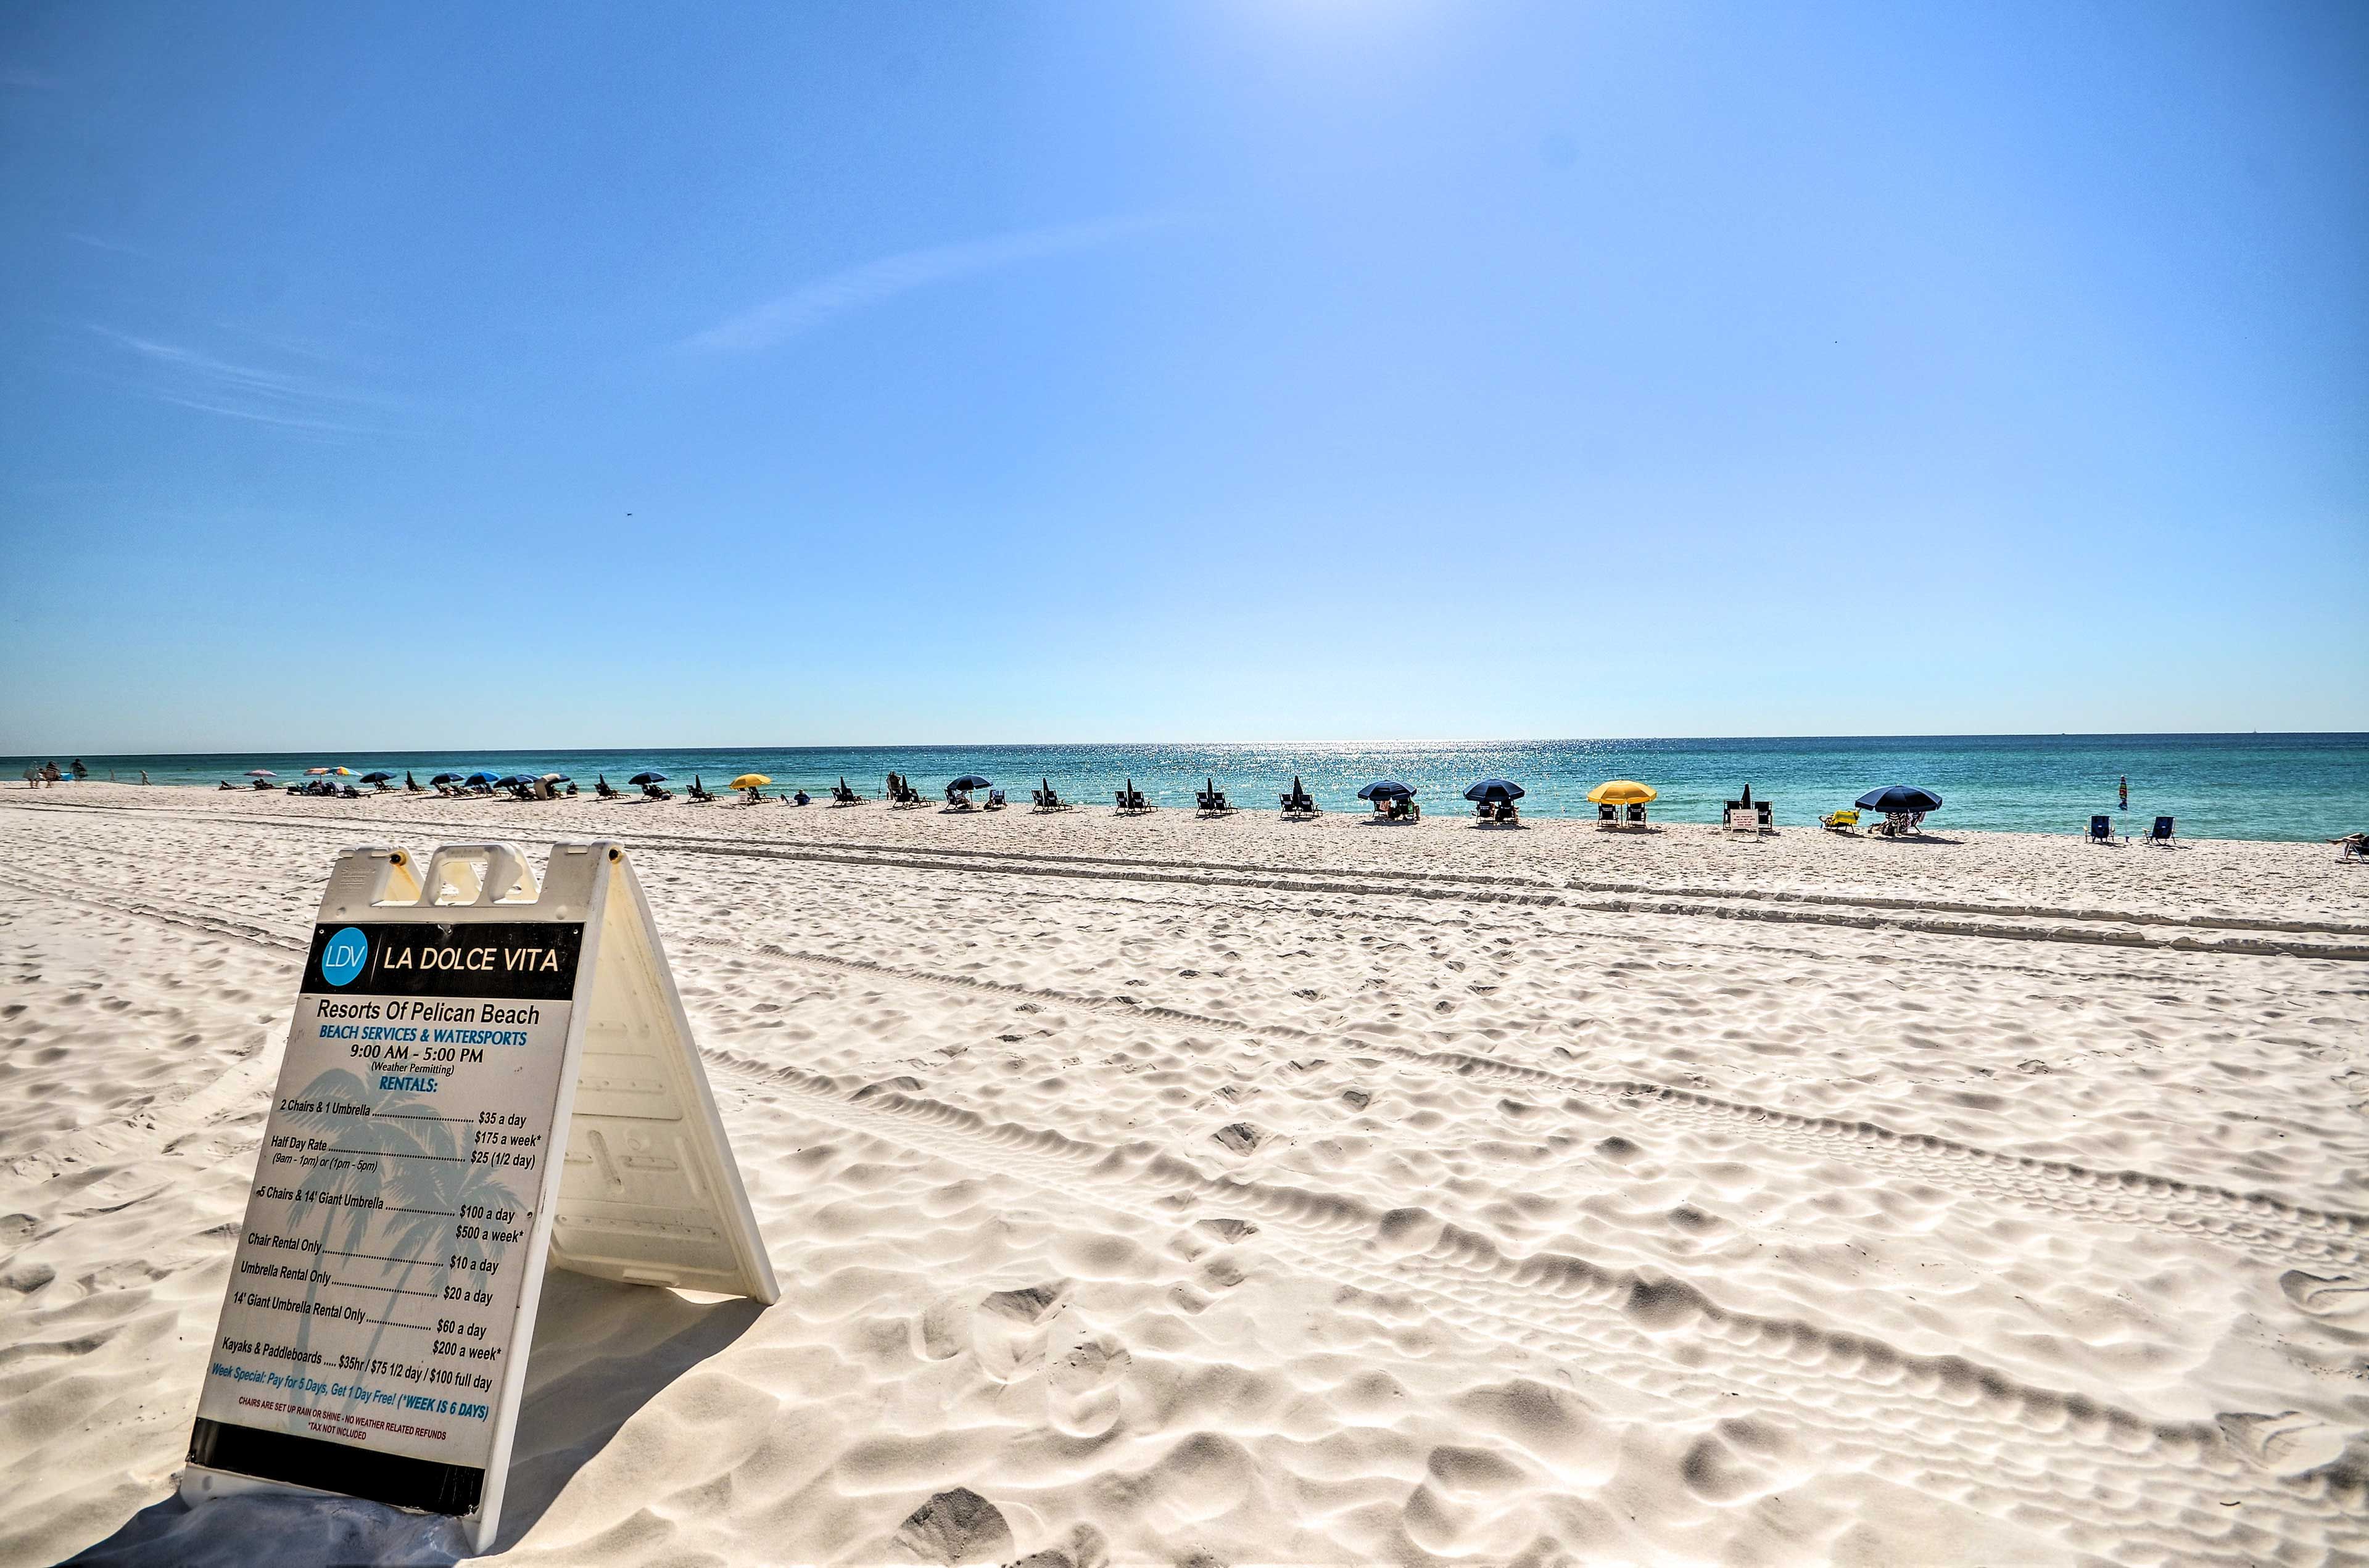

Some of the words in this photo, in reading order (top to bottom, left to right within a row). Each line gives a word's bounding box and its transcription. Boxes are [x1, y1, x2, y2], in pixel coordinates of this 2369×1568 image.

[325, 945, 366, 967] LDV
[384, 947, 413, 969] LA
[420, 947, 497, 971] DOLCE
[505, 948, 558, 972] VITA
[317, 1000, 380, 1020] Resorts
[386, 1001, 407, 1020] Of
[411, 1002, 475, 1023] Pelican
[481, 1004, 540, 1025] Beach
[319, 1026, 358, 1039] BEACH
[361, 1028, 416, 1042] SERVICES
[420, 1030, 429, 1042] &
[433, 1030, 527, 1046] WATERSPORTS
[350, 1044, 381, 1059] 9:00
[384, 1046, 408, 1060] AM
[423, 1047, 455, 1062] 5:00
[460, 1049, 484, 1063] PM
[371, 1061, 407, 1073] (Weather
[409, 1063, 455, 1075] Permitting)
[379, 1076, 438, 1093] RENTALS:
[281, 1100, 287, 1110] 2
[288, 1100, 314, 1113] Chairs
[315, 1102, 323, 1113] &
[325, 1104, 331, 1113] 1
[333, 1104, 371, 1116] Umbrella
[478, 1112, 496, 1124] $35
[498, 1116, 505, 1125] a
[507, 1115, 527, 1128] day
[474, 1132, 498, 1144] $175
[500, 1135, 507, 1145] a
[271, 1136, 289, 1149] Half
[290, 1137, 307, 1152] Day
[308, 1140, 327, 1152] Rate
[471, 1152, 489, 1164] $25
[491, 1153, 511, 1168] (1/2
[513, 1154, 535, 1170] day)
[273, 1153, 291, 1166] (9am
[299, 1156, 318, 1168] 1pm)
[320, 1158, 328, 1166] or
[329, 1158, 349, 1170] (1pm
[357, 1160, 378, 1173] 5pm)
[260, 1186, 265, 1197] 5
[266, 1187, 293, 1200] Chairs
[294, 1189, 302, 1201] &
[304, 1190, 317, 1202] 14'
[318, 1192, 342, 1205] Giant
[344, 1194, 384, 1209] Umbrella
[459, 1205, 484, 1219] $100
[486, 1209, 493, 1219] a
[495, 1208, 515, 1223] day
[455, 1226, 479, 1240] $500
[482, 1229, 488, 1240] a
[247, 1234, 270, 1247] Chair
[271, 1237, 299, 1252] Rental
[300, 1241, 322, 1255] Only
[449, 1255, 468, 1270] $10
[470, 1261, 476, 1271] a
[479, 1260, 499, 1275] day
[240, 1261, 279, 1279] Umbrella
[280, 1266, 308, 1282] Rental
[309, 1270, 331, 1286] Only
[443, 1285, 461, 1300] $20
[464, 1290, 471, 1301] a
[473, 1290, 494, 1305] day
[233, 1292, 246, 1305] 14'
[247, 1294, 270, 1309] Giant
[271, 1297, 311, 1315] Umbrella
[312, 1303, 342, 1319] Rental
[344, 1306, 366, 1324] Only
[437, 1320, 455, 1334] $60
[457, 1325, 464, 1335] a
[466, 1324, 487, 1340] day
[432, 1340, 457, 1356] $200
[459, 1345, 466, 1357] a
[222, 1337, 252, 1354] Kayaks
[254, 1343, 260, 1355] &
[262, 1343, 322, 1364] Paddleboards
[338, 1356, 364, 1372] $35hr
[365, 1358, 370, 1372] /
[371, 1360, 387, 1374] $75
[389, 1362, 403, 1377] 1/2
[405, 1363, 422, 1381] day
[423, 1366, 428, 1381] /
[429, 1366, 453, 1385] $100
[455, 1371, 472, 1387] full
[474, 1373, 492, 1392] day
[211, 1363, 234, 1379] Week
[234, 1367, 265, 1384] Special:
[267, 1372, 285, 1390] Pay
[286, 1374, 297, 1389] for
[298, 1377, 305, 1390] 5
[306, 1380, 328, 1396] Days,
[330, 1382, 346, 1398] Get
[348, 1386, 353, 1398] 1
[354, 1387, 373, 1402] Day
[374, 1389, 397, 1406] Free!
[436, 1399, 447, 1413] IS
[449, 1402, 457, 1415] 6
[458, 1403, 489, 1421] DAYS)
[239, 1396, 260, 1408] CHAIRS
[261, 1400, 275, 1409] ARE
[275, 1401, 287, 1411] SET
[287, 1404, 296, 1413] UP
[297, 1406, 312, 1416] RAIN
[313, 1408, 321, 1417] OR
[322, 1410, 341, 1421] SHINE
[345, 1414, 354, 1423] NO
[355, 1416, 385, 1429] WEATHER
[386, 1421, 414, 1434] RELATED
[415, 1426, 446, 1440] REFUNDS
[323, 1424, 336, 1434] NOT
[337, 1426, 366, 1440] INCLUDED
